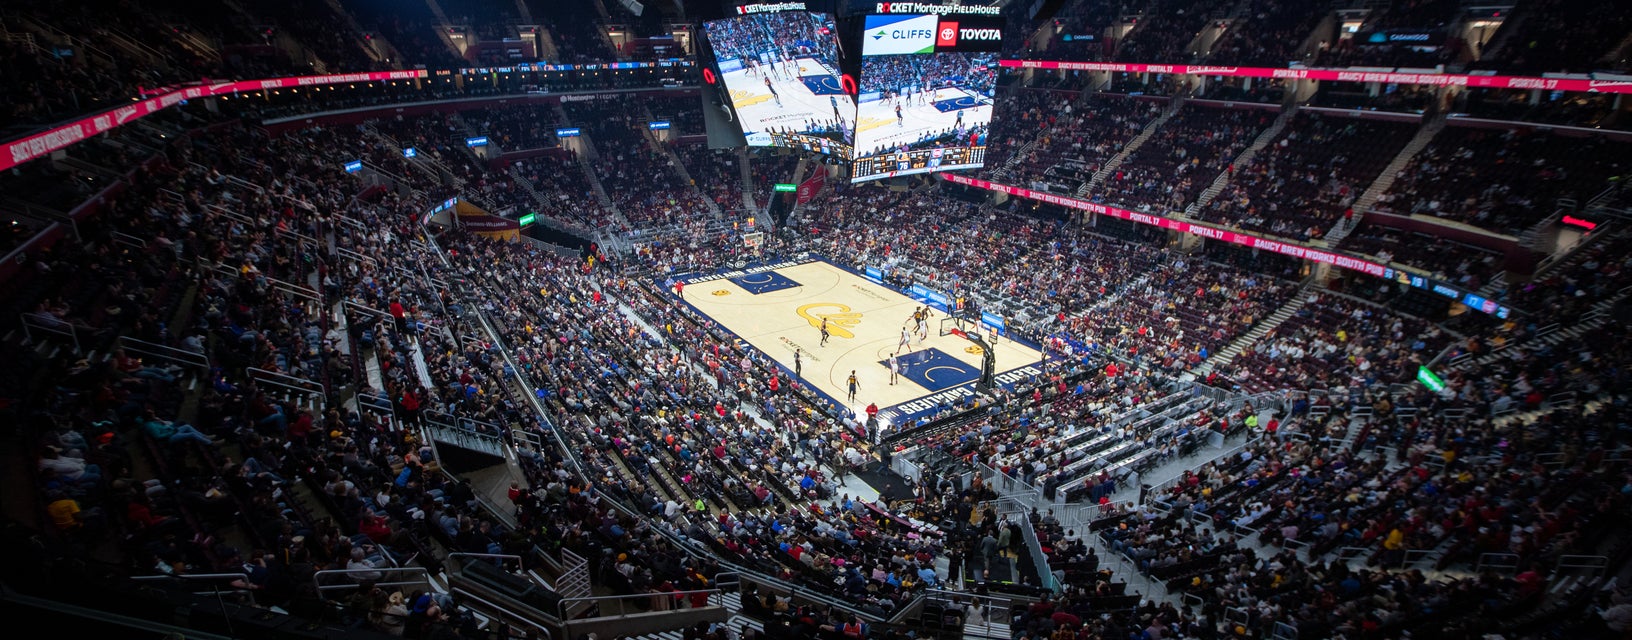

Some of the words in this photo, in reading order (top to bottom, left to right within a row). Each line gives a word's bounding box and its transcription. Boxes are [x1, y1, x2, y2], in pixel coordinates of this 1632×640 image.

[736, 4, 759, 14] ROCKET
[759, 3, 781, 13] Mortgage
[876, 2, 913, 14] ROCKET
[914, 2, 952, 15] Mortgage
[892, 30, 931, 39] CLIFFS
[960, 29, 1001, 40] TOYOTA
[1273, 69, 1299, 78] PORTAL
[1299, 70, 1308, 78] 17
[1338, 72, 1363, 81] SAUCY
[1364, 73, 1386, 82] BREW
[1388, 73, 1417, 83] WORKS
[1508, 78, 1546, 89] PORTAL
[899, 162, 909, 170] 76
[930, 159, 939, 167] 70
[953, 175, 967, 184] PORTAL
[990, 183, 1006, 192] PORTAL
[1029, 191, 1045, 201] SAUCY
[1045, 194, 1059, 203] BREW
[1060, 197, 1077, 207] WORKS
[1077, 201, 1094, 211] SOUTH
[1095, 205, 1106, 213] PUB
[1129, 212, 1152, 224] PORTAL
[1153, 217, 1160, 225] 17
[1189, 225, 1215, 238] PORTAL
[1215, 230, 1223, 239] 17
[1254, 239, 1280, 252] SAUCY
[1280, 245, 1305, 257] BREW
[1305, 250, 1334, 263] WORKS
[1336, 256, 1364, 270] SOUTH
[1365, 263, 1384, 276] PUB
[688, 270, 745, 284] CLEVELAND
[746, 260, 797, 274] CAVALIERS
